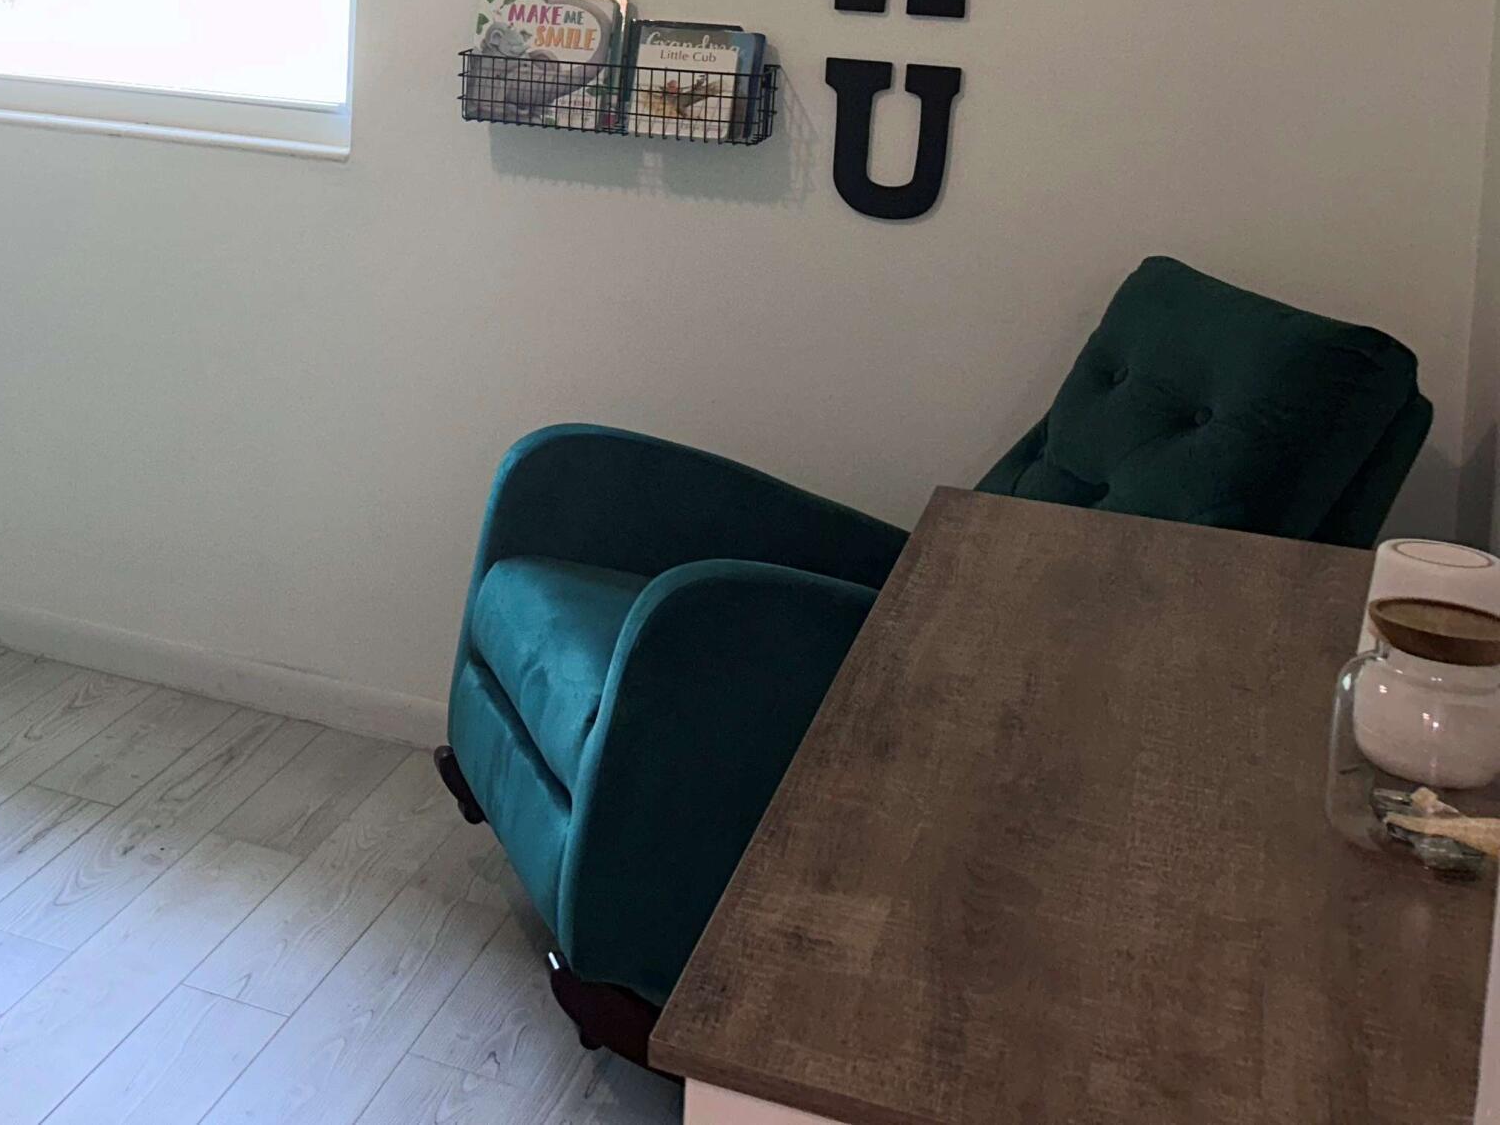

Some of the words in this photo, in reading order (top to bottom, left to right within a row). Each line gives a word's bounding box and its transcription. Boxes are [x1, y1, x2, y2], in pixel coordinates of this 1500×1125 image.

[508, 3, 563, 26] MAKE
[563, 10, 585, 25] ME
[534, 25, 598, 51] SMILE
[660, 49, 689, 61] Little
[692, 52, 717, 63] Cub
